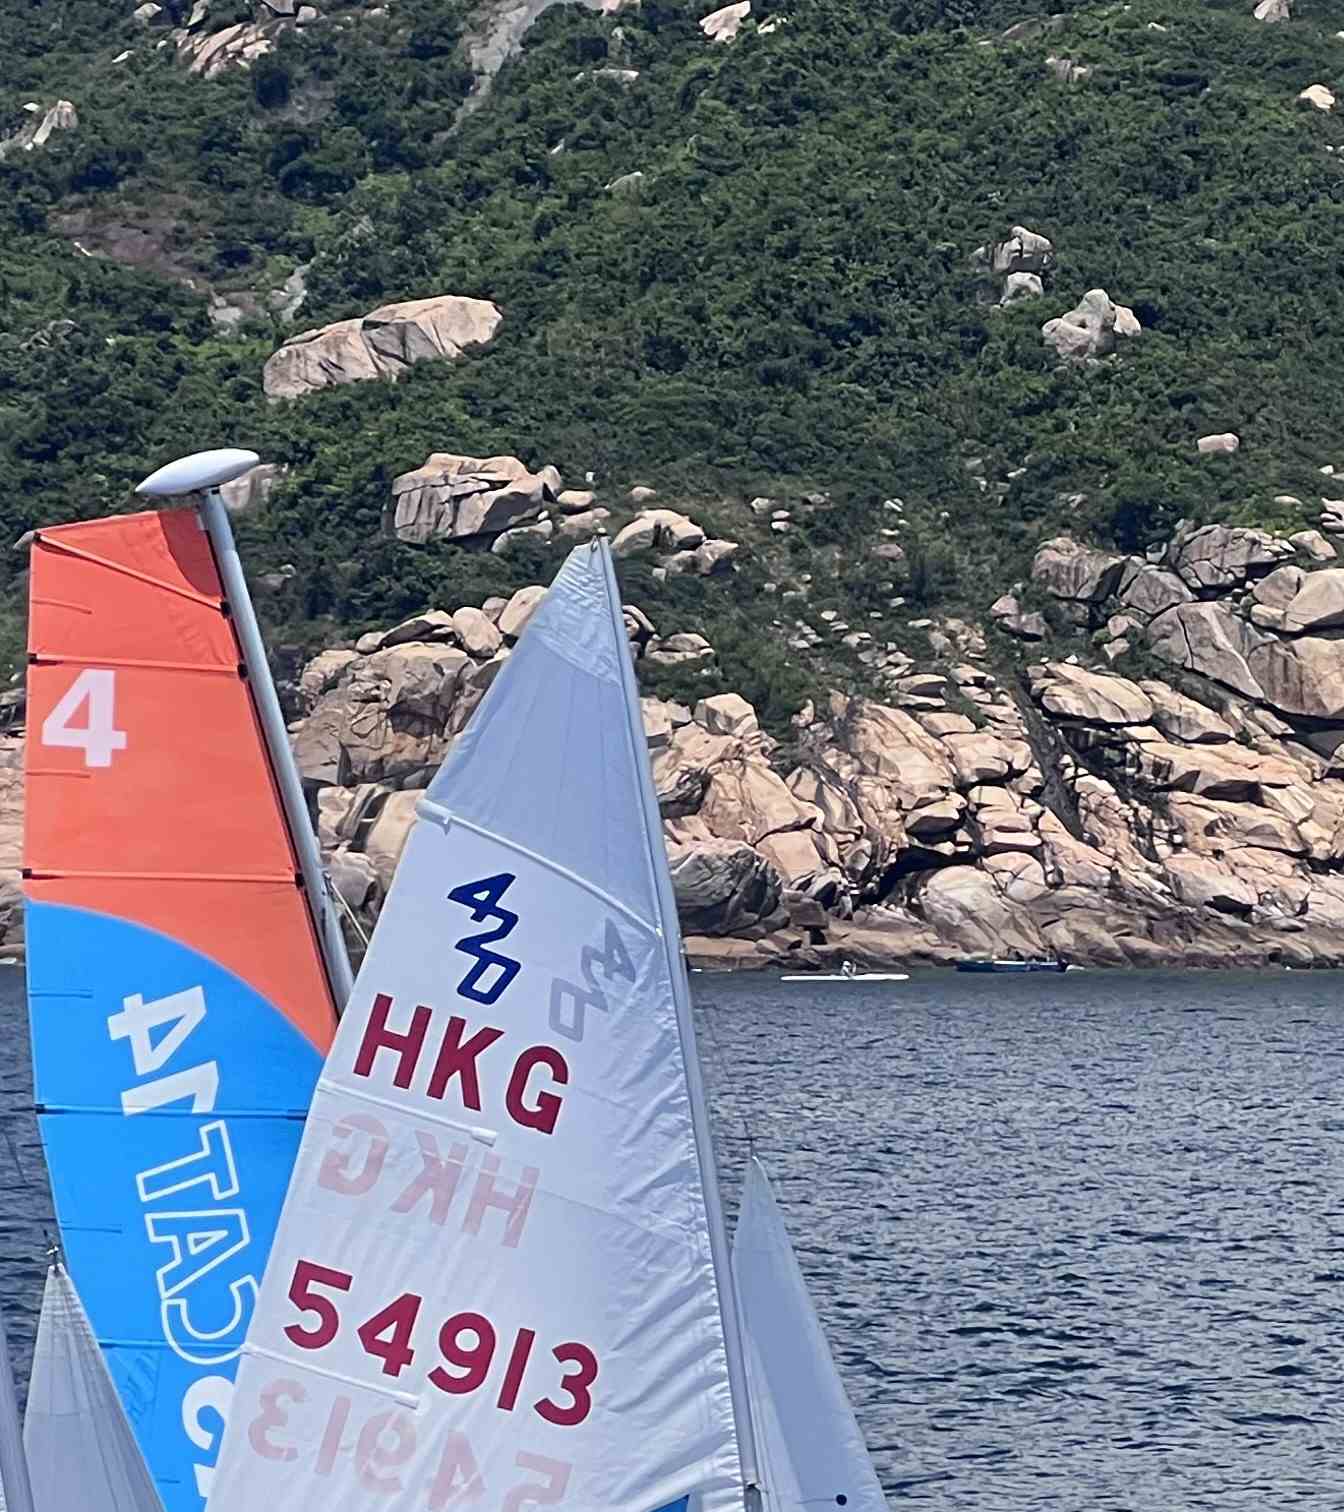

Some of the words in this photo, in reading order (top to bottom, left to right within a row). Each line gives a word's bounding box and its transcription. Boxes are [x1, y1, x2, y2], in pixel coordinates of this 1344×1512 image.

[41, 669, 127, 768] 4
[447, 872, 522, 1006] 420
[353, 992, 571, 1136] HKG
[282, 1259, 601, 1427] 54913
